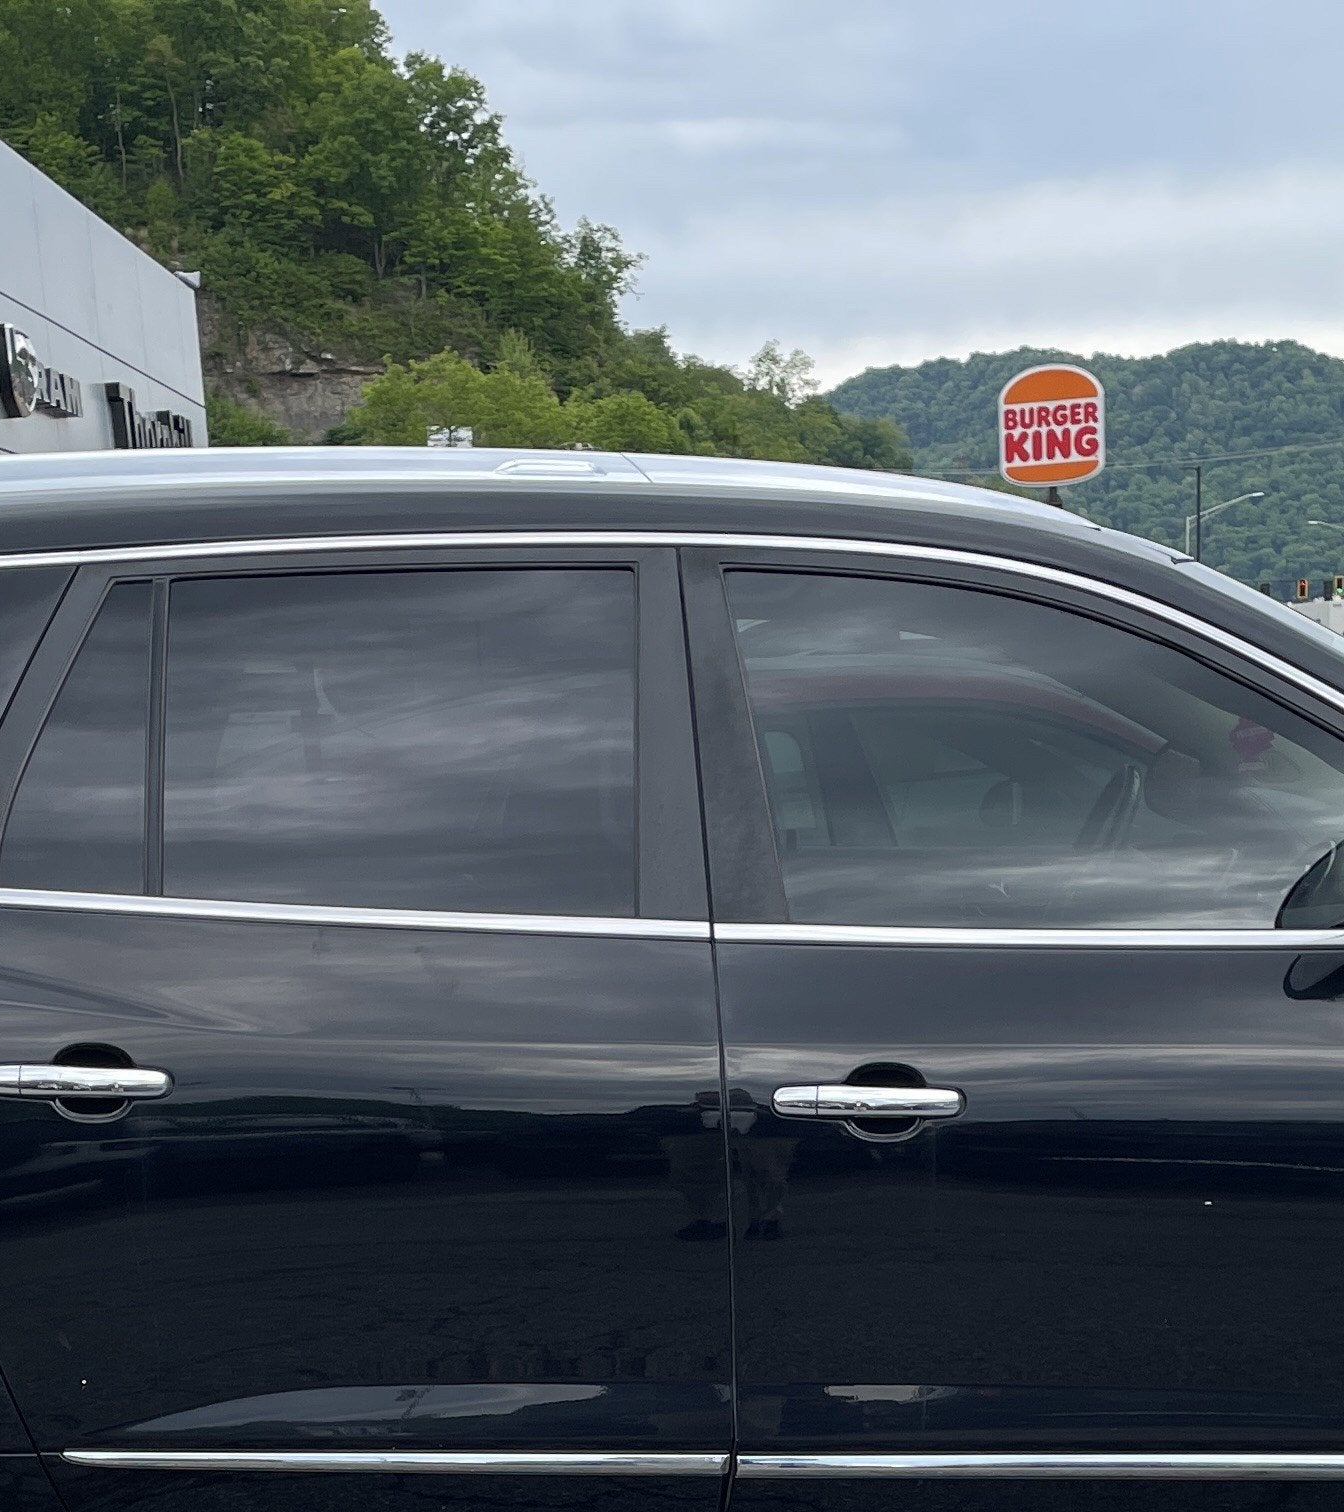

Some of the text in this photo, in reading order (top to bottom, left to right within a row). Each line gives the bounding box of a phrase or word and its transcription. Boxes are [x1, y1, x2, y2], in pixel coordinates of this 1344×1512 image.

[35, 361, 83, 418] RAM
[1003, 402, 1099, 431] BURGER
[1004, 426, 1099, 464] KING
